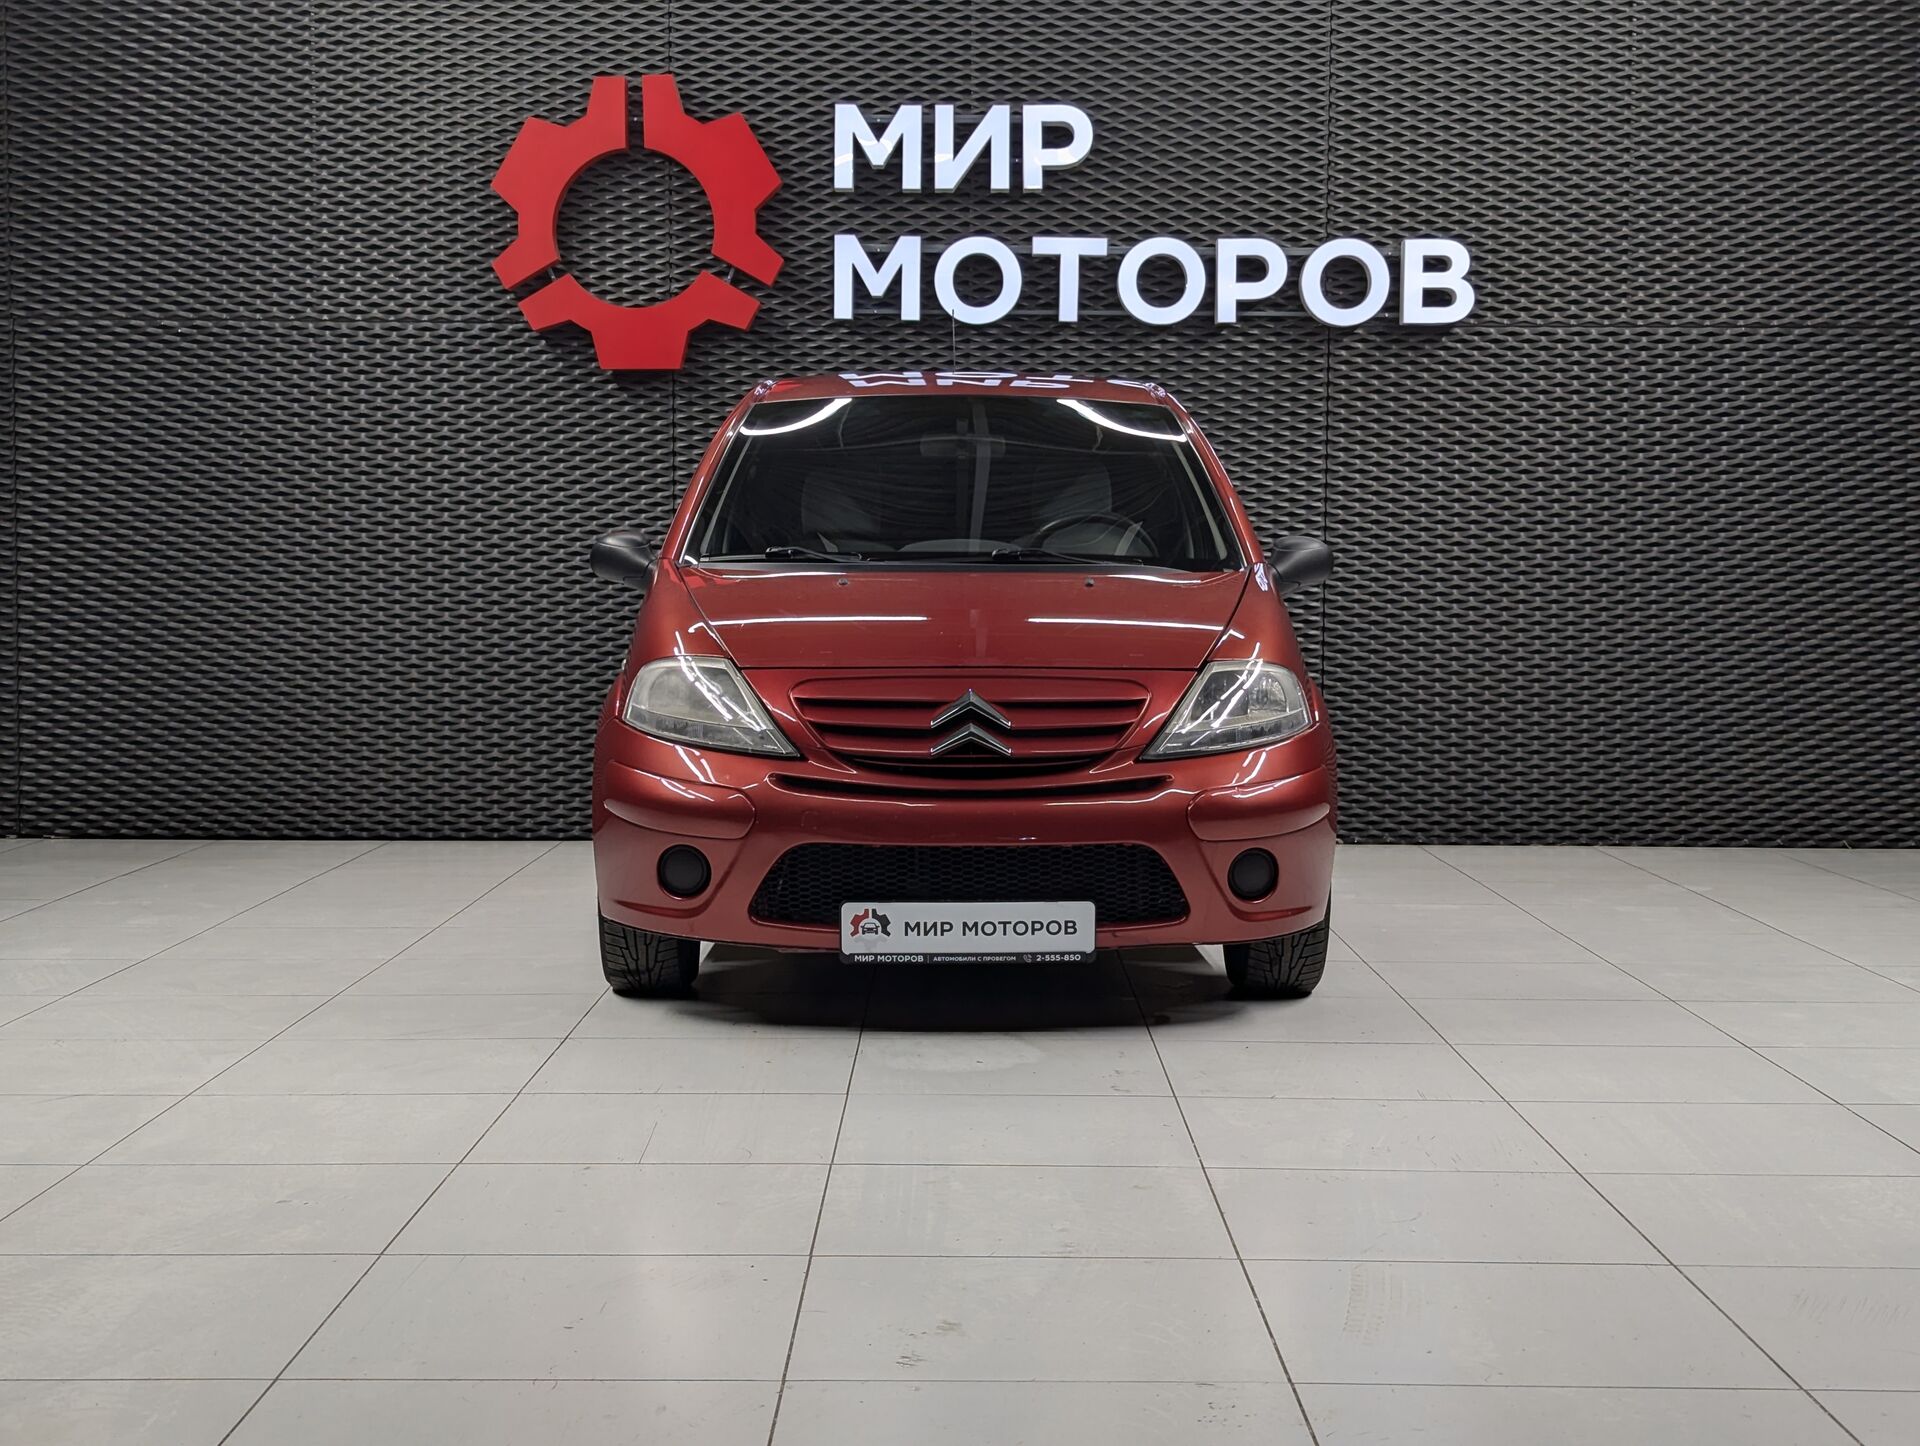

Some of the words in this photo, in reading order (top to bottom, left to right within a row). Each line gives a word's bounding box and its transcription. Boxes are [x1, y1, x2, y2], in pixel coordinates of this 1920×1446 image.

[834, 103, 1095, 194] МИР
[833, 233, 1477, 326] МОТОРОВ
[904, 921, 954, 937] МИР
[962, 919, 1078, 937] МОТОРОВ
[854, 954, 875, 962] МИР
[877, 954, 924, 962] МОТОРОВ
[1036, 954, 1081, 962] 2-555-850
